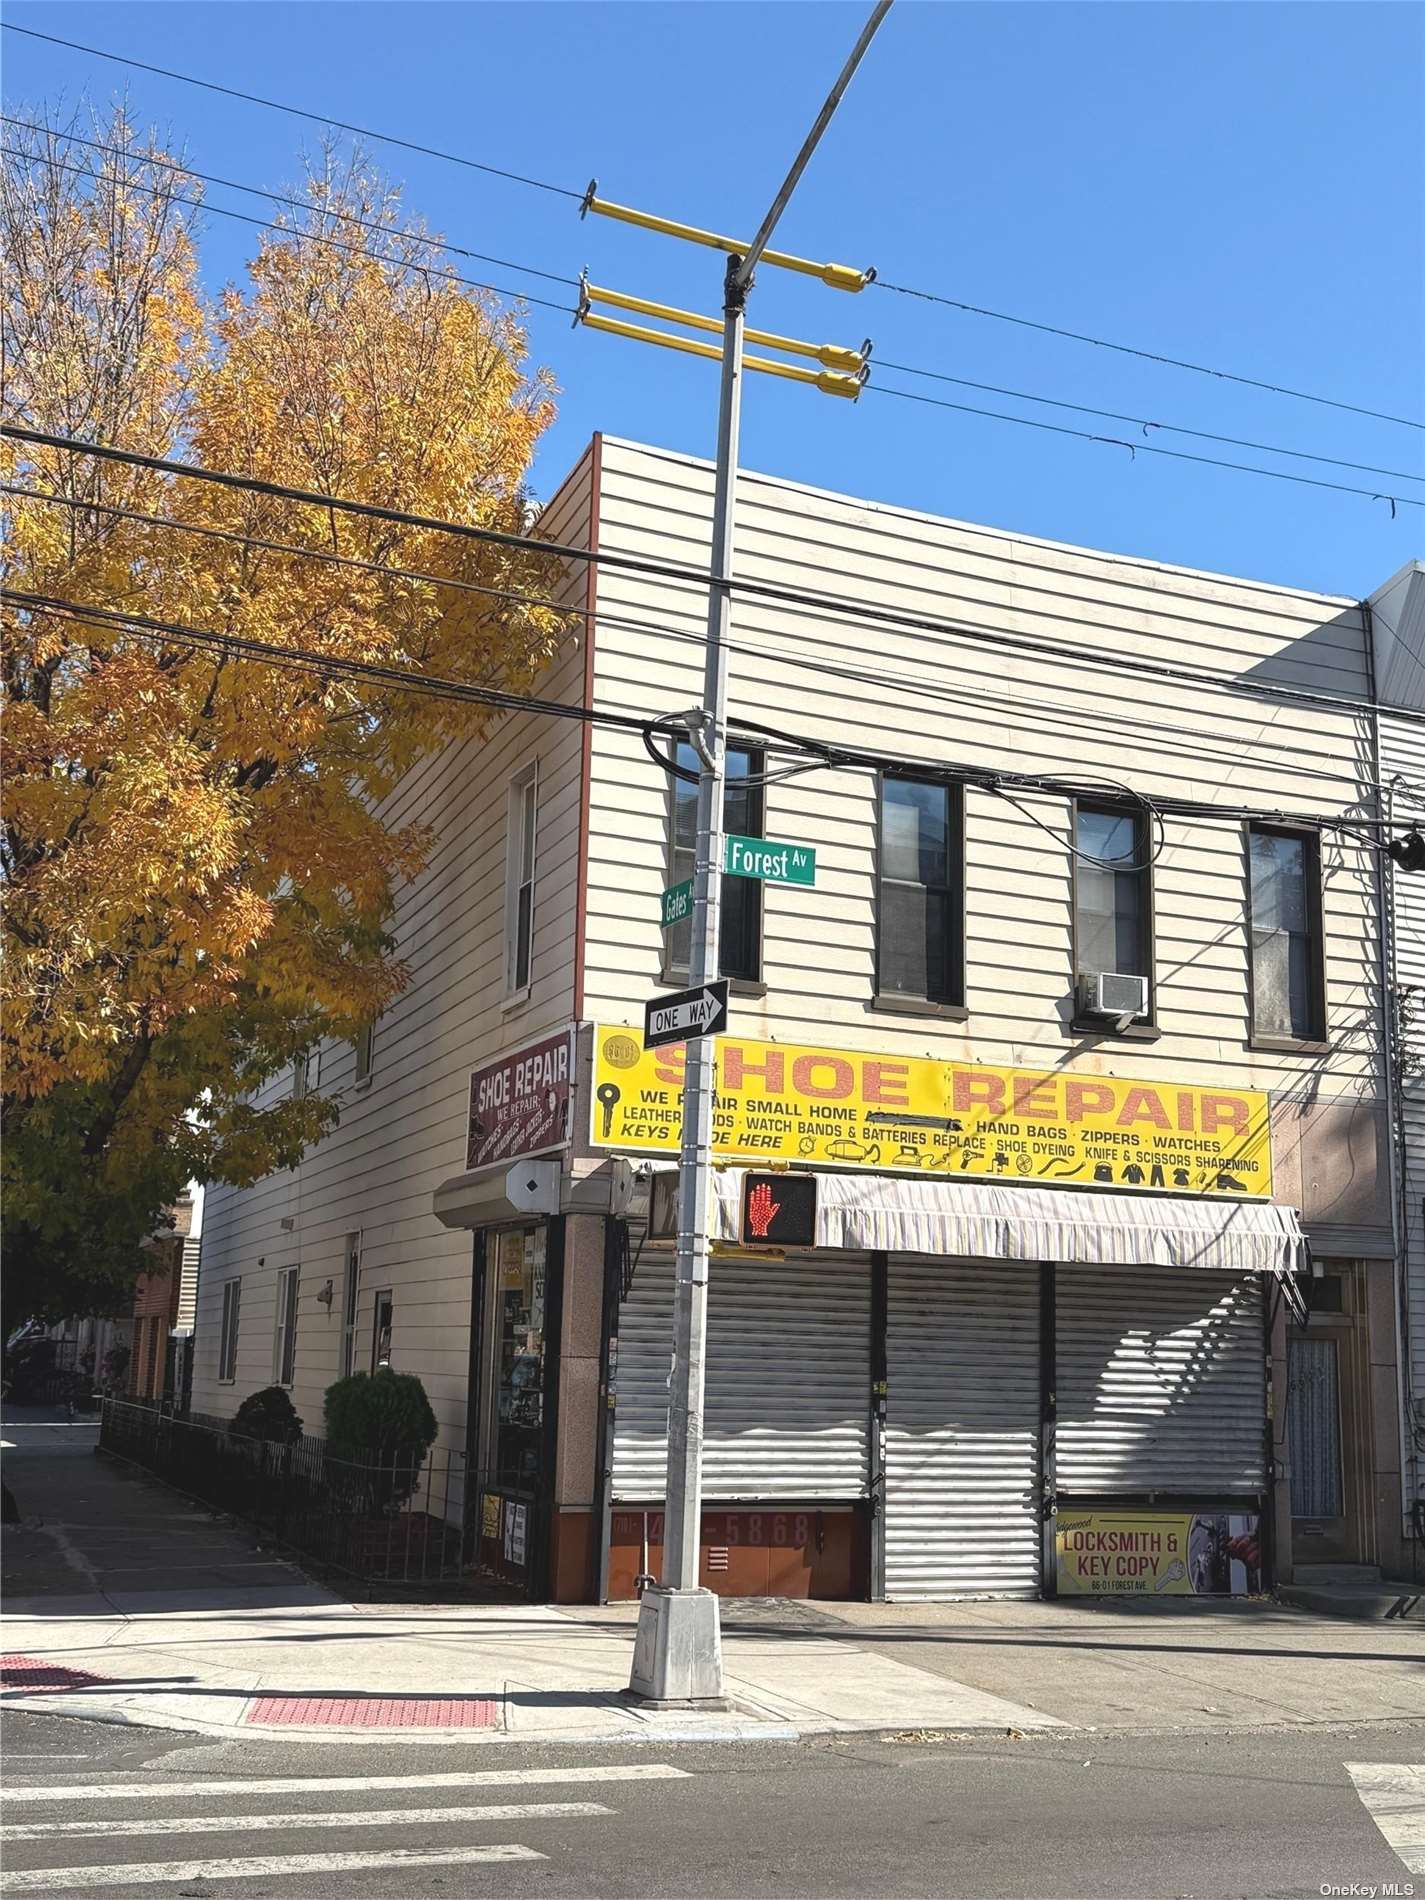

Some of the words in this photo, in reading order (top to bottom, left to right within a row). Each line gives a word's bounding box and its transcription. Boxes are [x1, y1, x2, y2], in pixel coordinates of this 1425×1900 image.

[731, 843, 788, 877] Forest
[792, 850, 807, 867] Av
[666, 891, 687, 921] Gates
[656, 1009, 679, 1031] ONE
[689, 999, 714, 1023] WAY
[478, 1067, 511, 1113] SHOE
[515, 1044, 568, 1098] REPAIR
[497, 1106, 508, 1121] WE
[623, 1106, 682, 1123] LEATHER
[640, 1090, 669, 1105] WE
[746, 1099, 802, 1116] SMALL
[809, 1105, 857, 1121] HOME
[952, 1071, 1250, 1136] REPAIR
[620, 1123, 670, 1139] KEYS
[738, 1133, 783, 1148] HERE
[746, 1116, 792, 1132] WATCH
[798, 1122, 842, 1137] BANDS
[848, 1126, 856, 1138] &
[862, 1127, 927, 1144] BATTERIES
[933, 1133, 986, 1149] REPLACE
[976, 1121, 1020, 1135] HAND
[1027, 1125, 1067, 1140] BAGS
[1081, 1129, 1140, 1146] ZIPPERS
[1153, 1135, 1220, 1152] WATCHES
[996, 1139, 1028, 1153] SHOE
[1033, 1142, 1075, 1157] DYEING
[1085, 1146, 1118, 1161] KNIFE
[1123, 1150, 1131, 1162] &
[1136, 1150, 1191, 1167] SCISSORS
[1063, 1531, 1161, 1552] LOCKSMITH
[1167, 1533, 1178, 1552] &
[1078, 1555, 1111, 1576] KEY
[1116, 1556, 1160, 1577] COPY
[1111, 1580, 1134, 1590] FOREST
